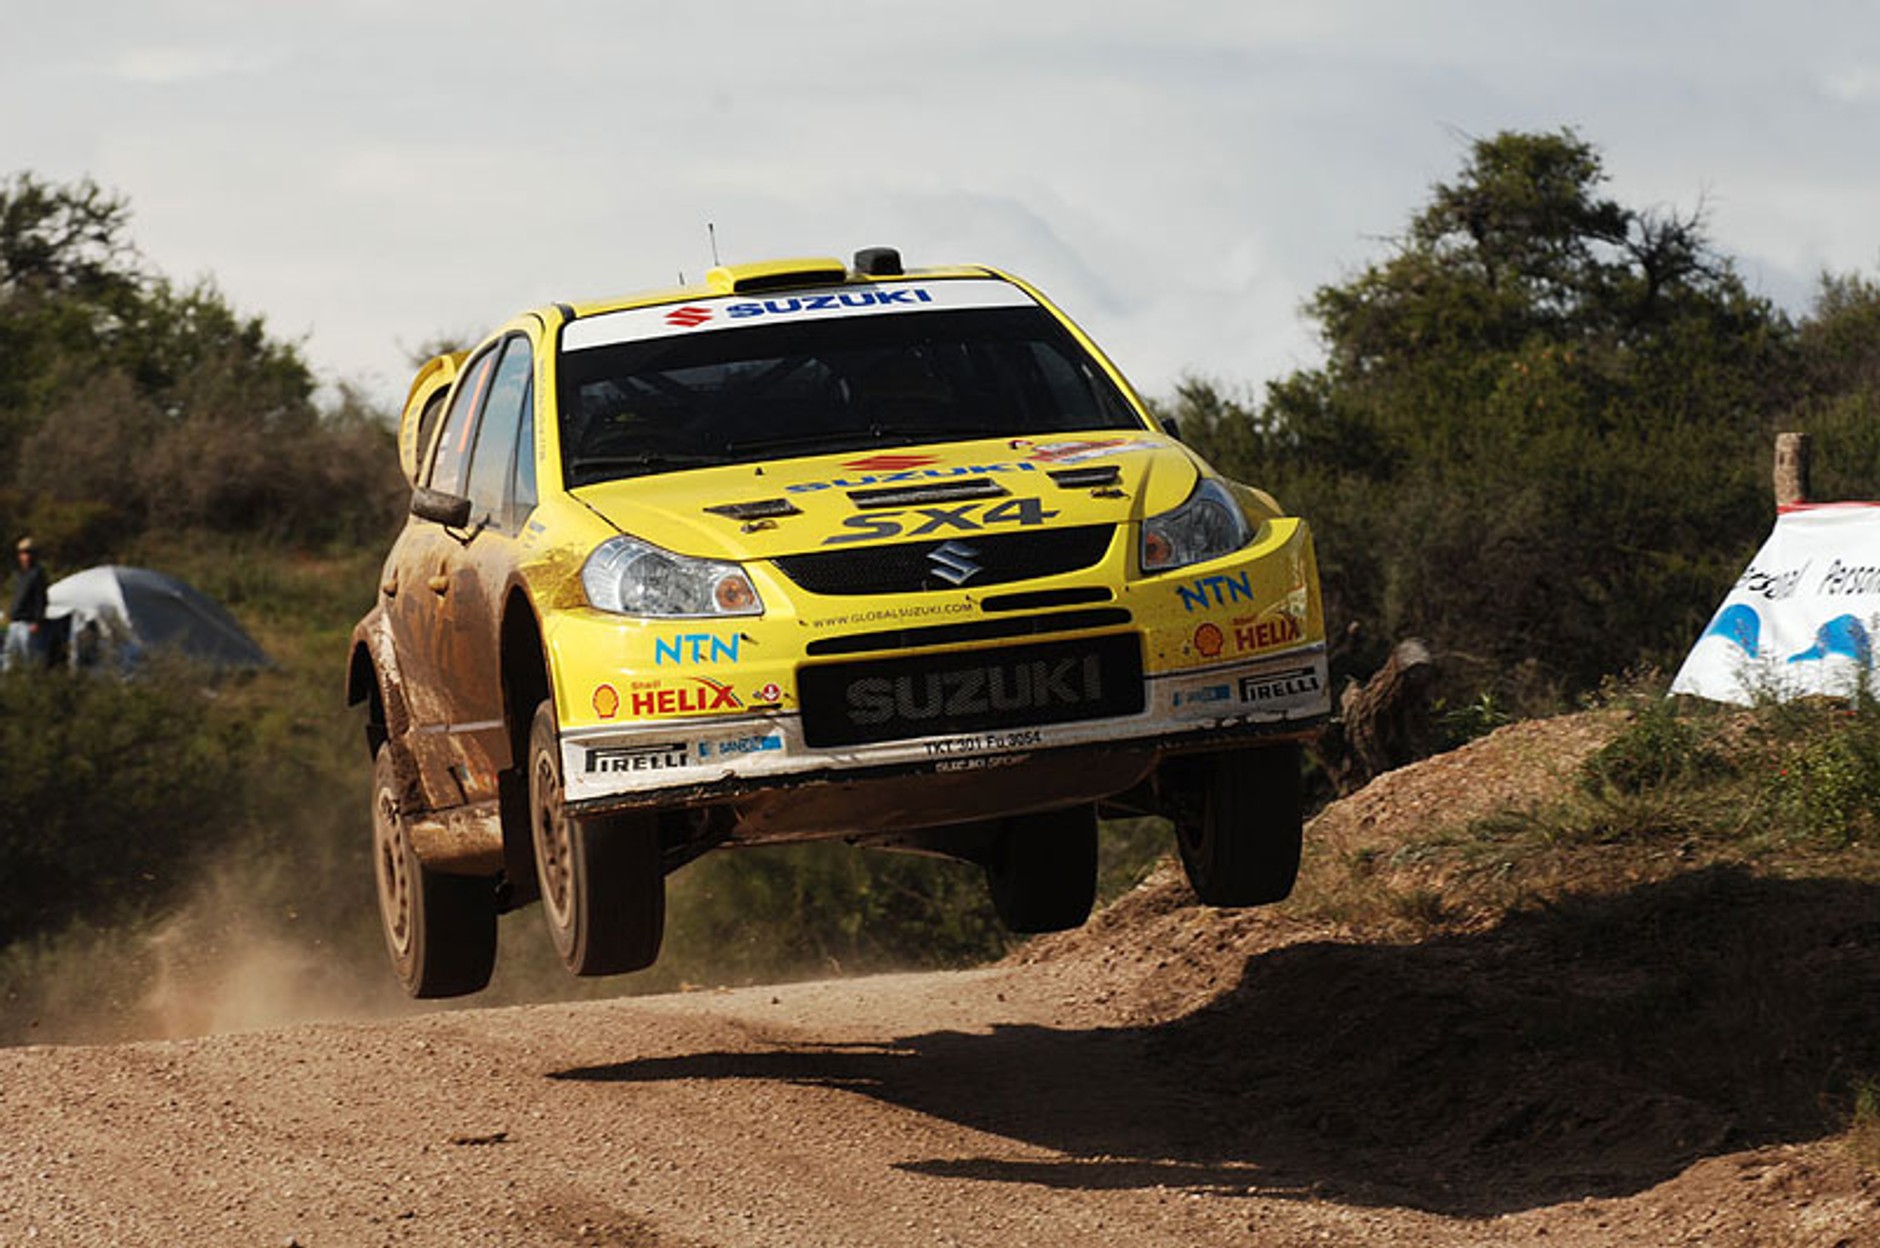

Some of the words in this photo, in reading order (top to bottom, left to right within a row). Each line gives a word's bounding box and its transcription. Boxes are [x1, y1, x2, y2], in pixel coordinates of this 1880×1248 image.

[726, 289, 934, 319] SUZUKI
[785, 462, 1037, 494] SUZUKI
[820, 497, 1061, 546] SX4
[1175, 571, 1254, 612] NTN
[655, 633, 740, 665] NTN
[1234, 615, 1302, 652] HELIX
[631, 685, 740, 716] HELIX
[847, 653, 1101, 725] SUZUKI
[1238, 666, 1320, 703] PIRELLI
[585, 742, 688, 773] PIRELLI
